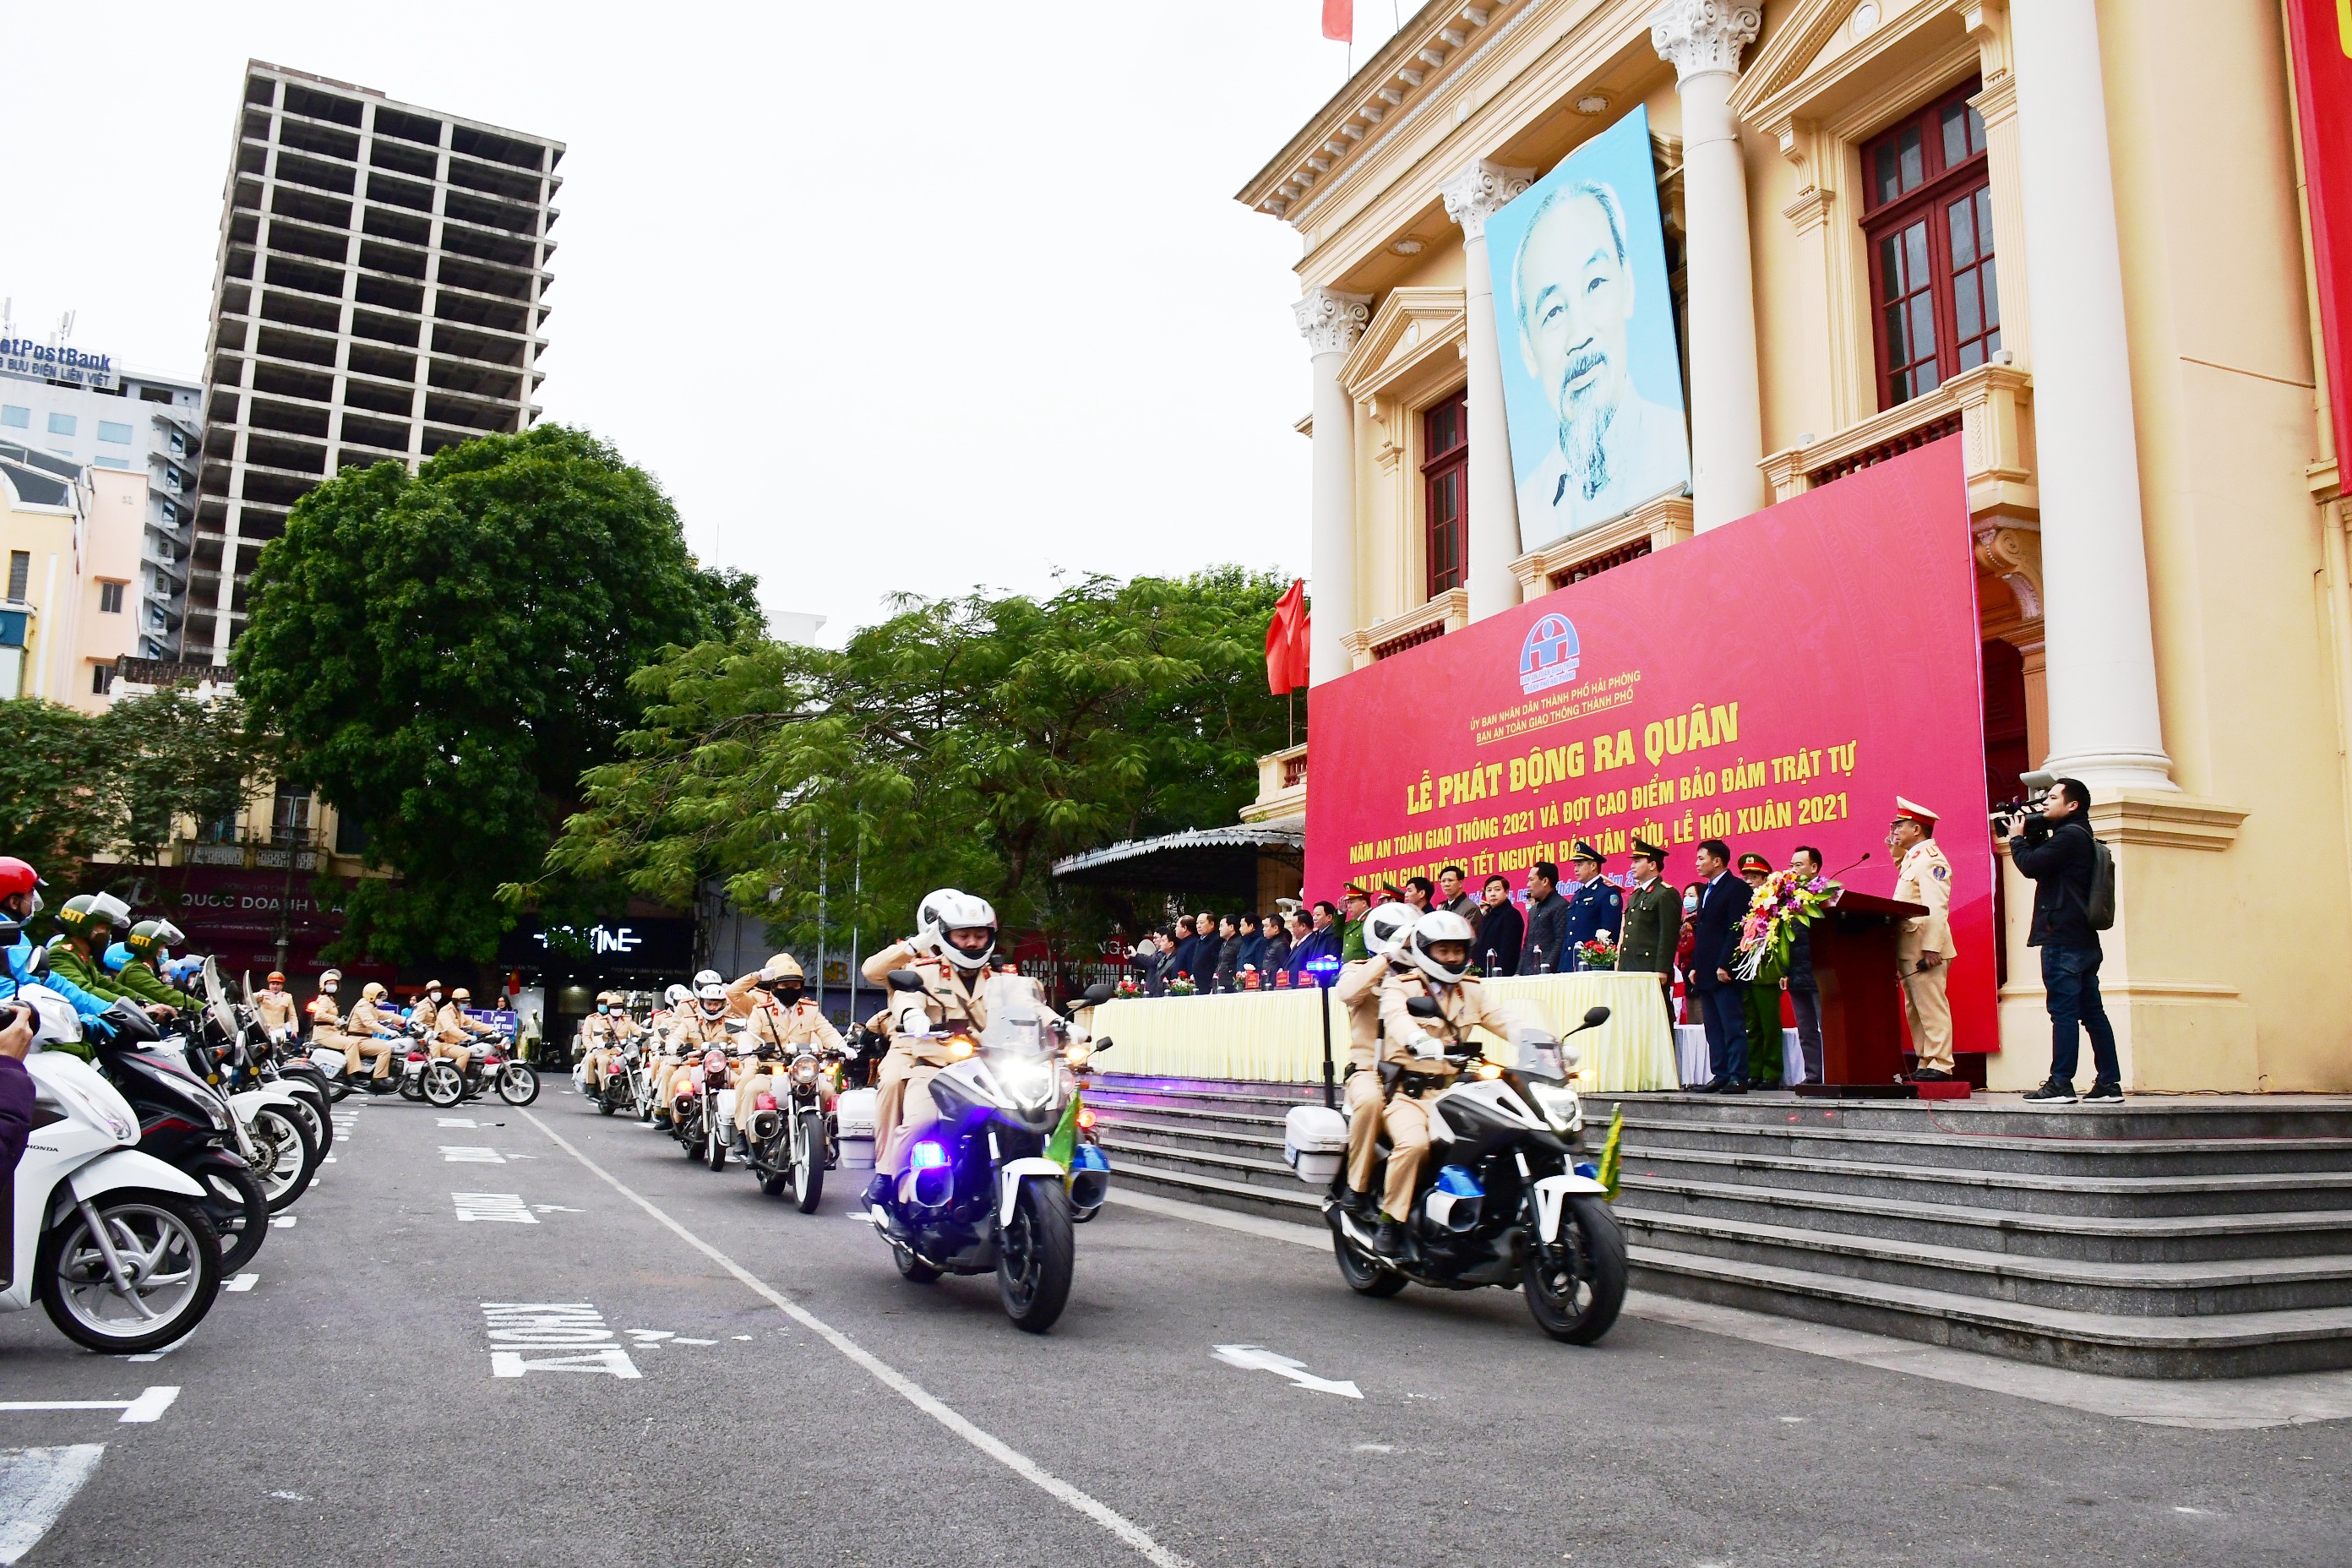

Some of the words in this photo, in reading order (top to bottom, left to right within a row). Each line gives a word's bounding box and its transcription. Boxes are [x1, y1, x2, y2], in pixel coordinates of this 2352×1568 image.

[1470, 716, 1479, 731] ỦY
[1482, 713, 1497, 727] BAN
[1499, 706, 1521, 724] NHÂN
[1522, 700, 1539, 716] DÂN
[1541, 691, 1570, 710] THÀNH
[1571, 681, 1590, 702] PHỐ
[1592, 677, 1606, 696] HẢI
[1608, 670, 1641, 689] PHÒNG
[1476, 730, 1492, 743] BAN
[1493, 727, 1504, 739] AN
[1505, 717, 1527, 737] TOÀN
[1528, 714, 1549, 728] GIAO
[1550, 704, 1580, 722] THÔNG
[1582, 695, 1612, 716] THÀNH
[1614, 683, 1634, 705] PHỐ
[1407, 770, 1433, 815] LỄ
[1438, 761, 1502, 808] PHÁT
[1509, 741, 1585, 794] ĐỘNG
[1593, 728, 1635, 772] RA
[1644, 701, 1738, 767] QUÂN
[1349, 841, 1373, 864] NĂM
[1376, 839, 1391, 859] AN
[1394, 830, 1422, 856] TOÀN
[1425, 826, 1451, 848] GIAO
[1456, 816, 1499, 843] THÔNG
[1503, 809, 1534, 836] 2021
[1540, 800, 1560, 828] VÀ
[1563, 796, 1592, 826] ĐỢT
[1596, 790, 1626, 817] CAO
[1631, 773, 1674, 811] ĐIỂM
[1680, 765, 1716, 802] BẢO
[1721, 757, 1766, 793] ĐẢM
[1772, 747, 1822, 785] TRẬT
[1827, 740, 1857, 777] TỰ
[1472, 847, 1494, 875] TẾT
[1499, 841, 1555, 873] NGUYÊN
[1595, 827, 1625, 856] TÂN
[1674, 808, 1694, 844] LỄ
[1700, 808, 1731, 840] HỘI
[1737, 798, 1792, 835] XUÂN
[1798, 792, 1848, 825] 2021
[60, 906, 86, 924] CSTT
[129, 934, 152, 947] CSTT
